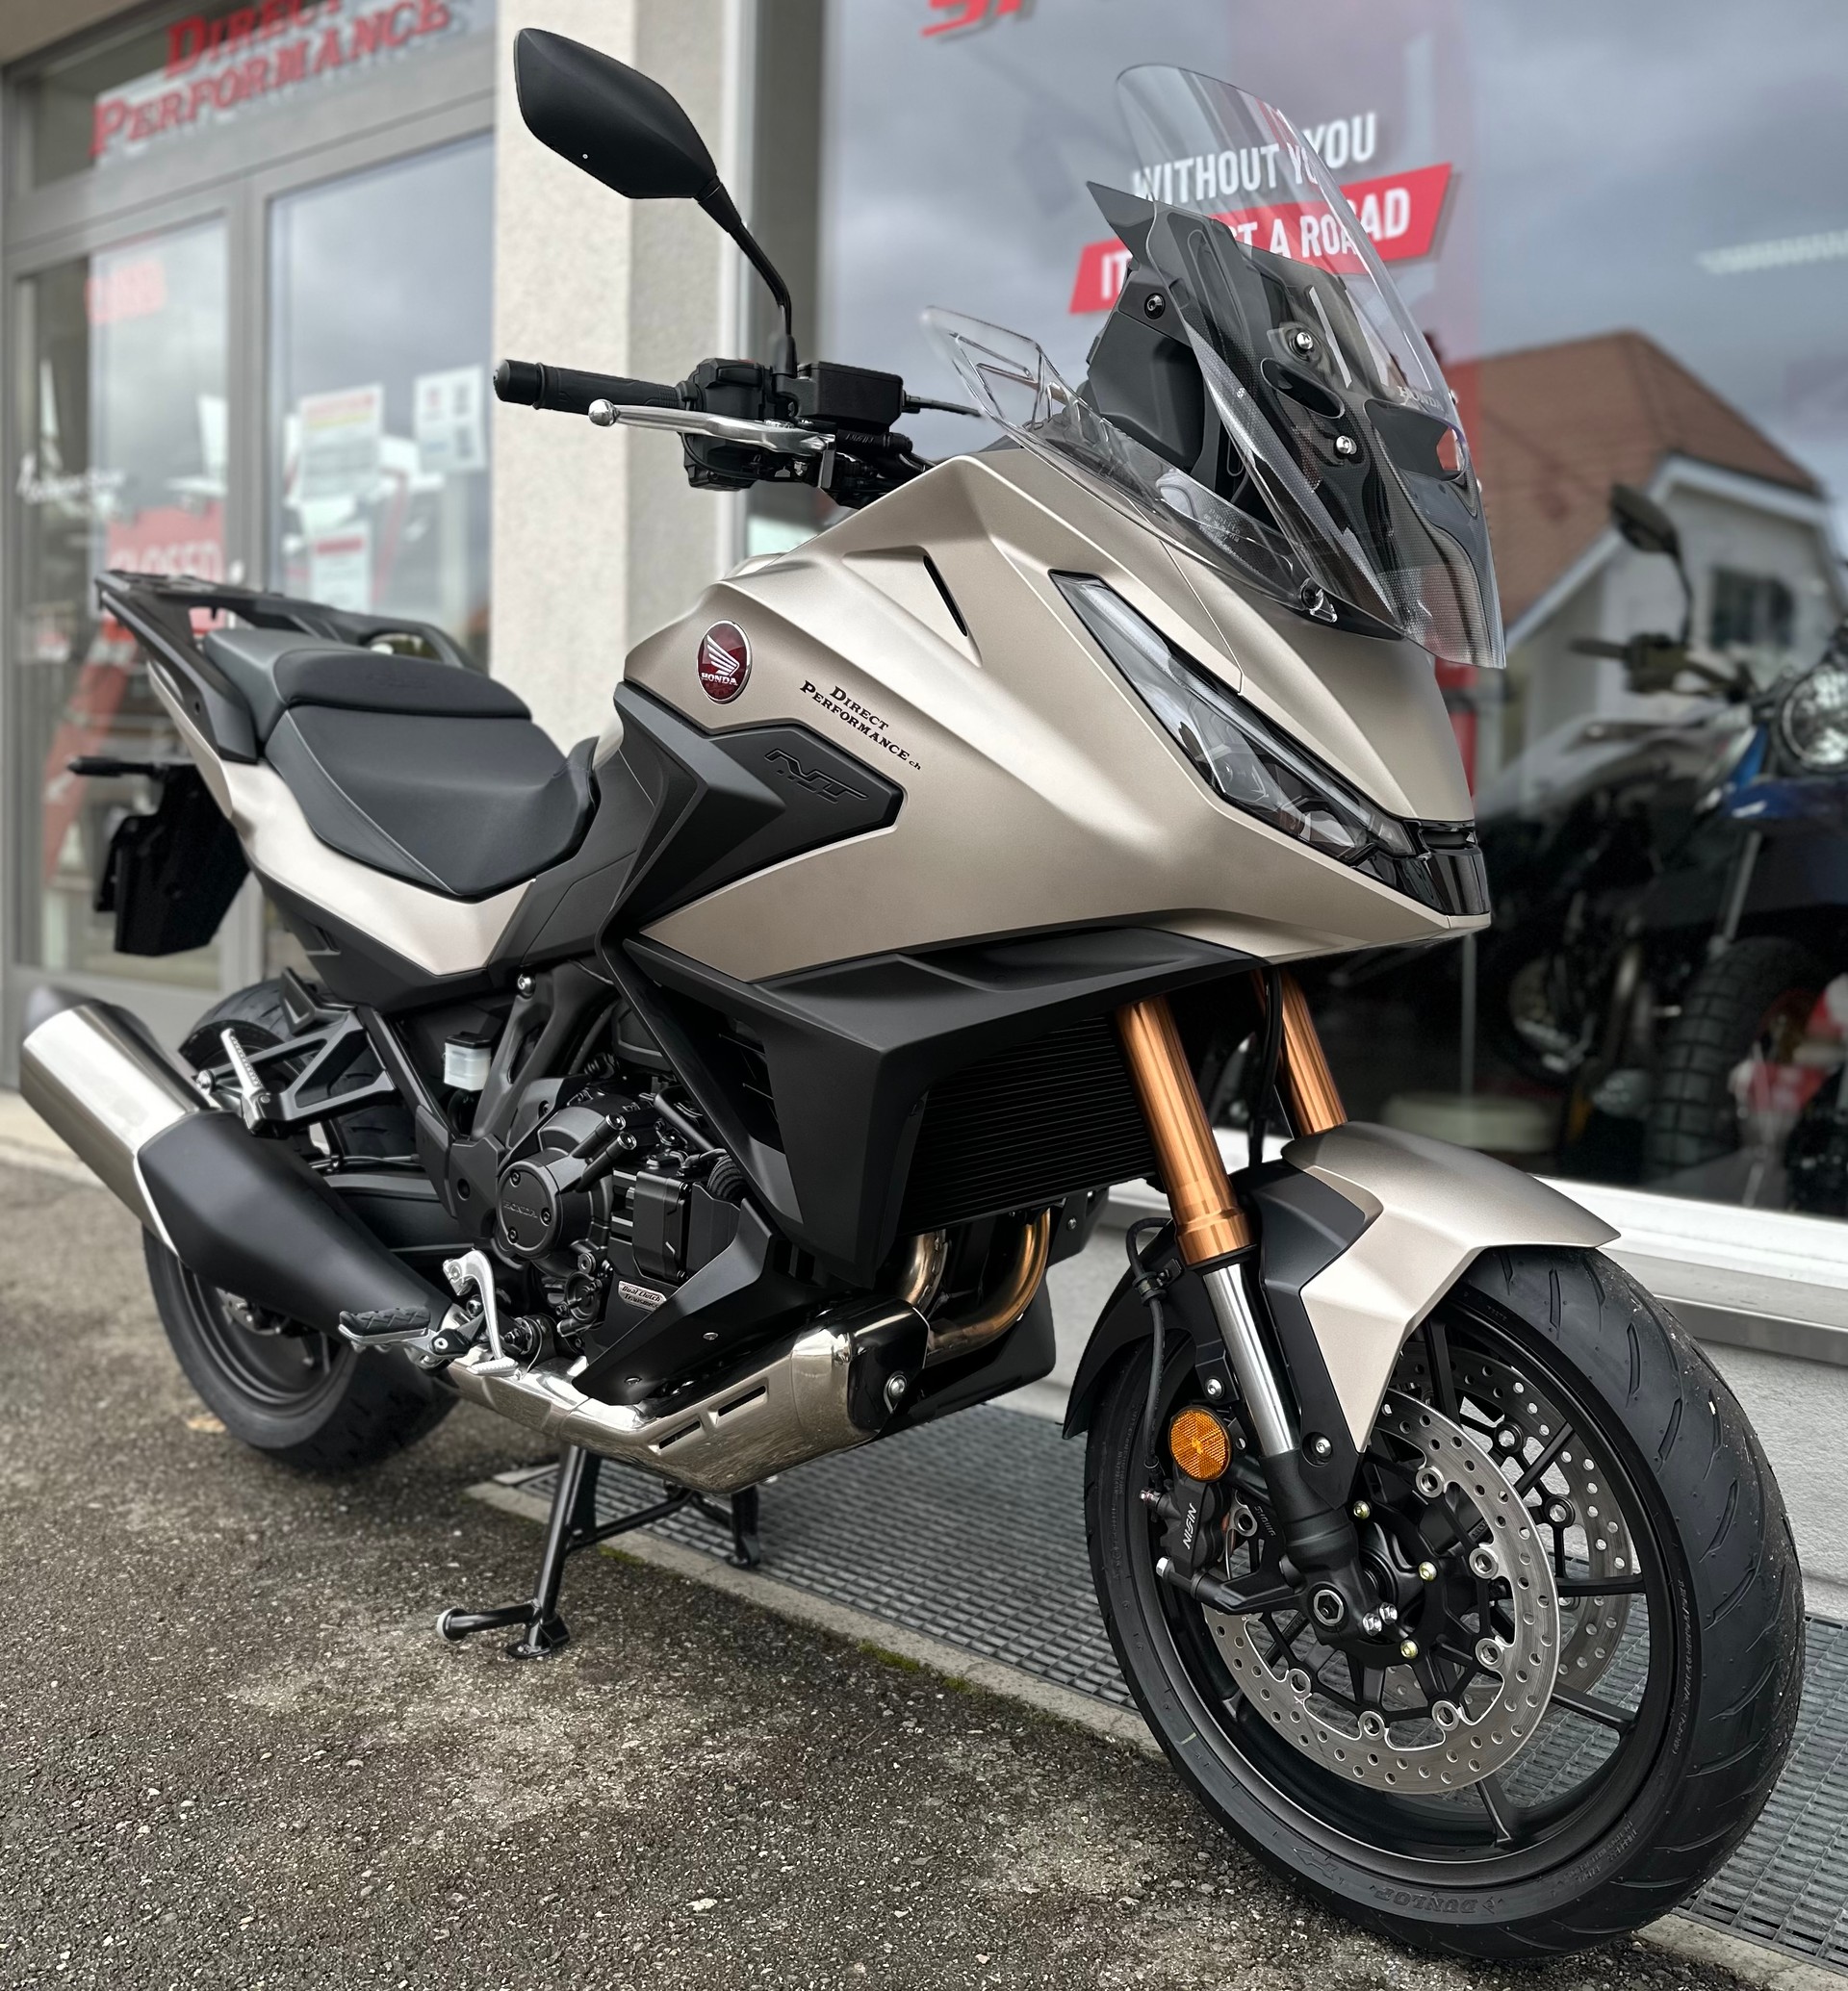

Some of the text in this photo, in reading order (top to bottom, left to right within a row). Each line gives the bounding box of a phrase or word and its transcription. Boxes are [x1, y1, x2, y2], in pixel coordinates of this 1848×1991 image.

[88, 0, 453, 160] PERFORMANCE
[1131, 143, 1281, 206] WITHOUT
[701, 672, 738, 686] HONDA
[799, 679, 911, 761] PERFORMANCE
[830, 685, 889, 731] DIRECT
[1182, 1502, 1197, 1550] NISSIN
[1373, 1887, 1479, 1915] DUNLOP
